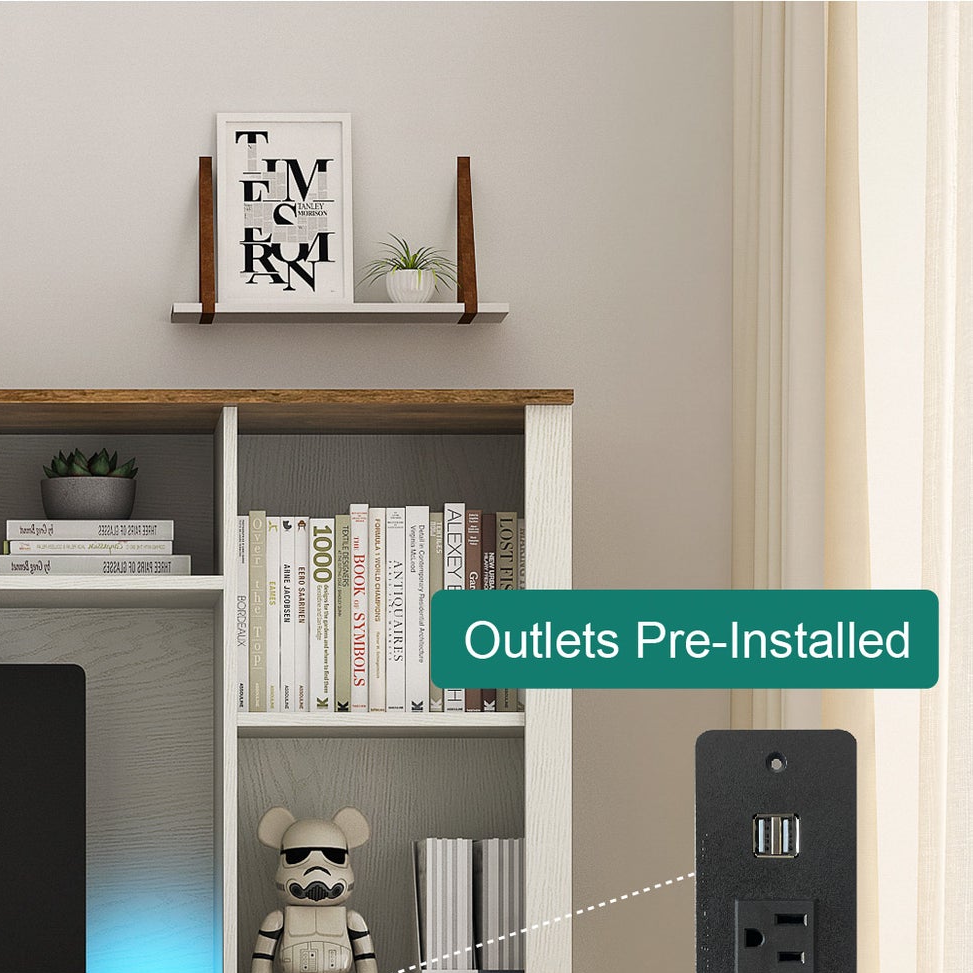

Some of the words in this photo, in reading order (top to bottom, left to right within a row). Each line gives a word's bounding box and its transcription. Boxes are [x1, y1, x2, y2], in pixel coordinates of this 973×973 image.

[313, 525, 332, 583] 1000
[447, 508, 462, 578] ALEXEY
[499, 518, 513, 562] LOST
[353, 554, 365, 595] BOOK
[237, 596, 247, 647] BORDEAUX
[391, 560, 403, 662] ANTIQUAIRES
[353, 612, 365, 687] SYMBOLS
